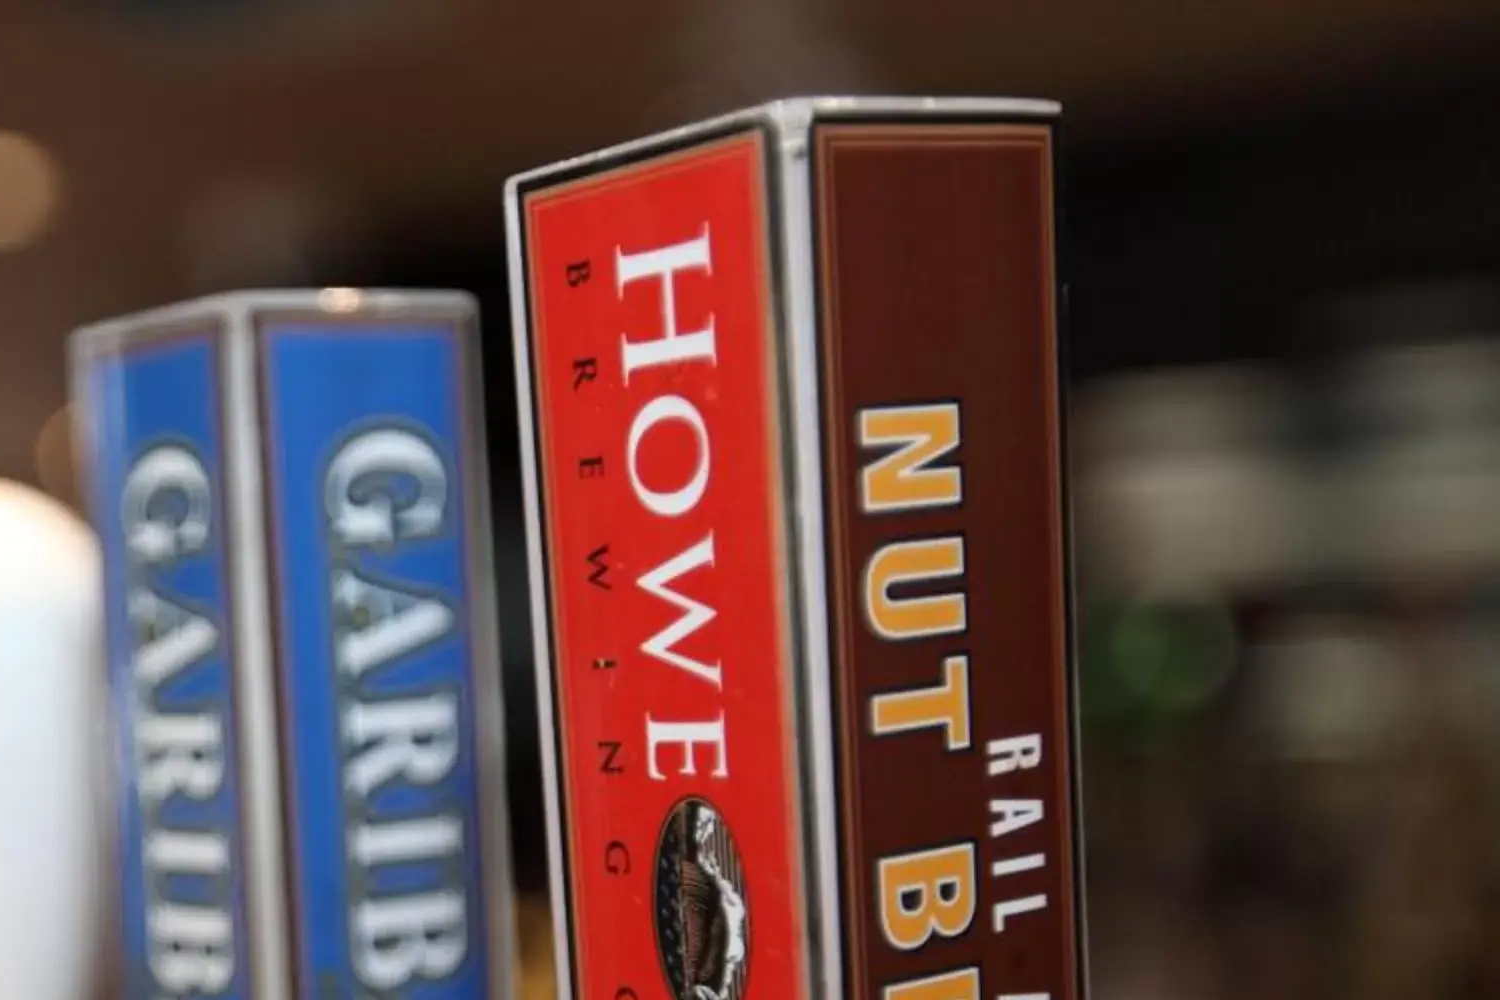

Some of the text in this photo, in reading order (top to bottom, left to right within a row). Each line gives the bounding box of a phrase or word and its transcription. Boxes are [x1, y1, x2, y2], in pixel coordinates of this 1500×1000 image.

[565, 259, 632, 877] BREWING
[613, 221, 731, 782] HOWE
[856, 400, 973, 754] NUT
[986, 731, 1050, 934] RAIL
